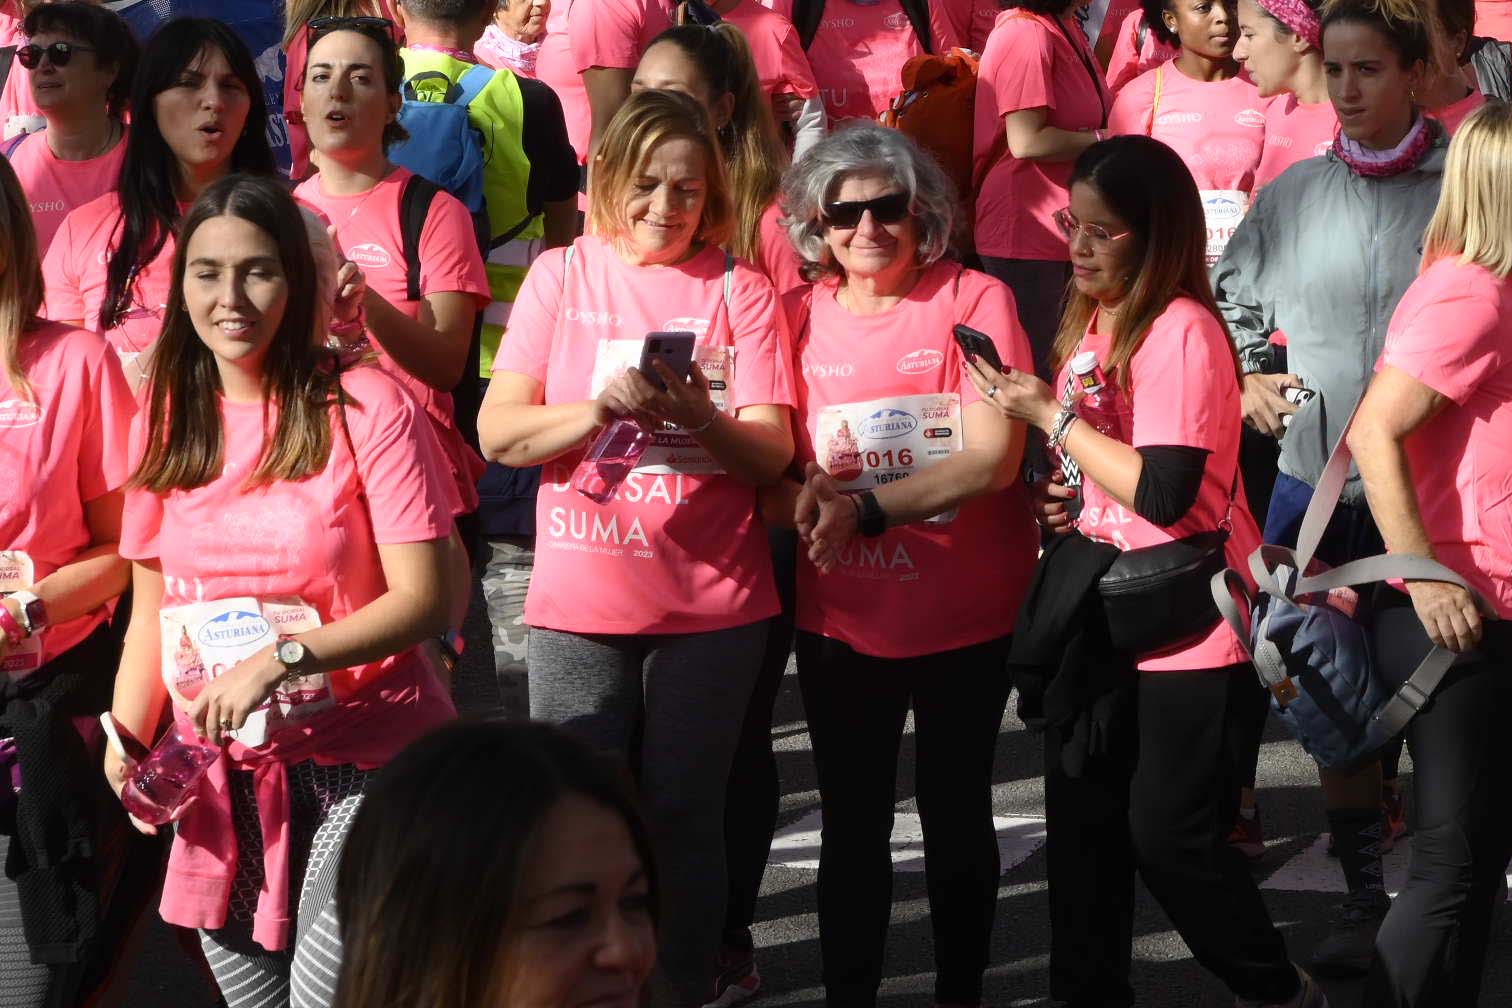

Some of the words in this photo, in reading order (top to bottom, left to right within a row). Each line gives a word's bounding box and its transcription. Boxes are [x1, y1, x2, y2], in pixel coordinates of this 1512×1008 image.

[565, 307, 623, 328] OYSHO
[922, 411, 950, 419] SUMA
[866, 448, 914, 468] 016
[549, 506, 650, 547] SUMA
[274, 613, 307, 624] SUMA
[204, 624, 265, 641] ASTURIANA
